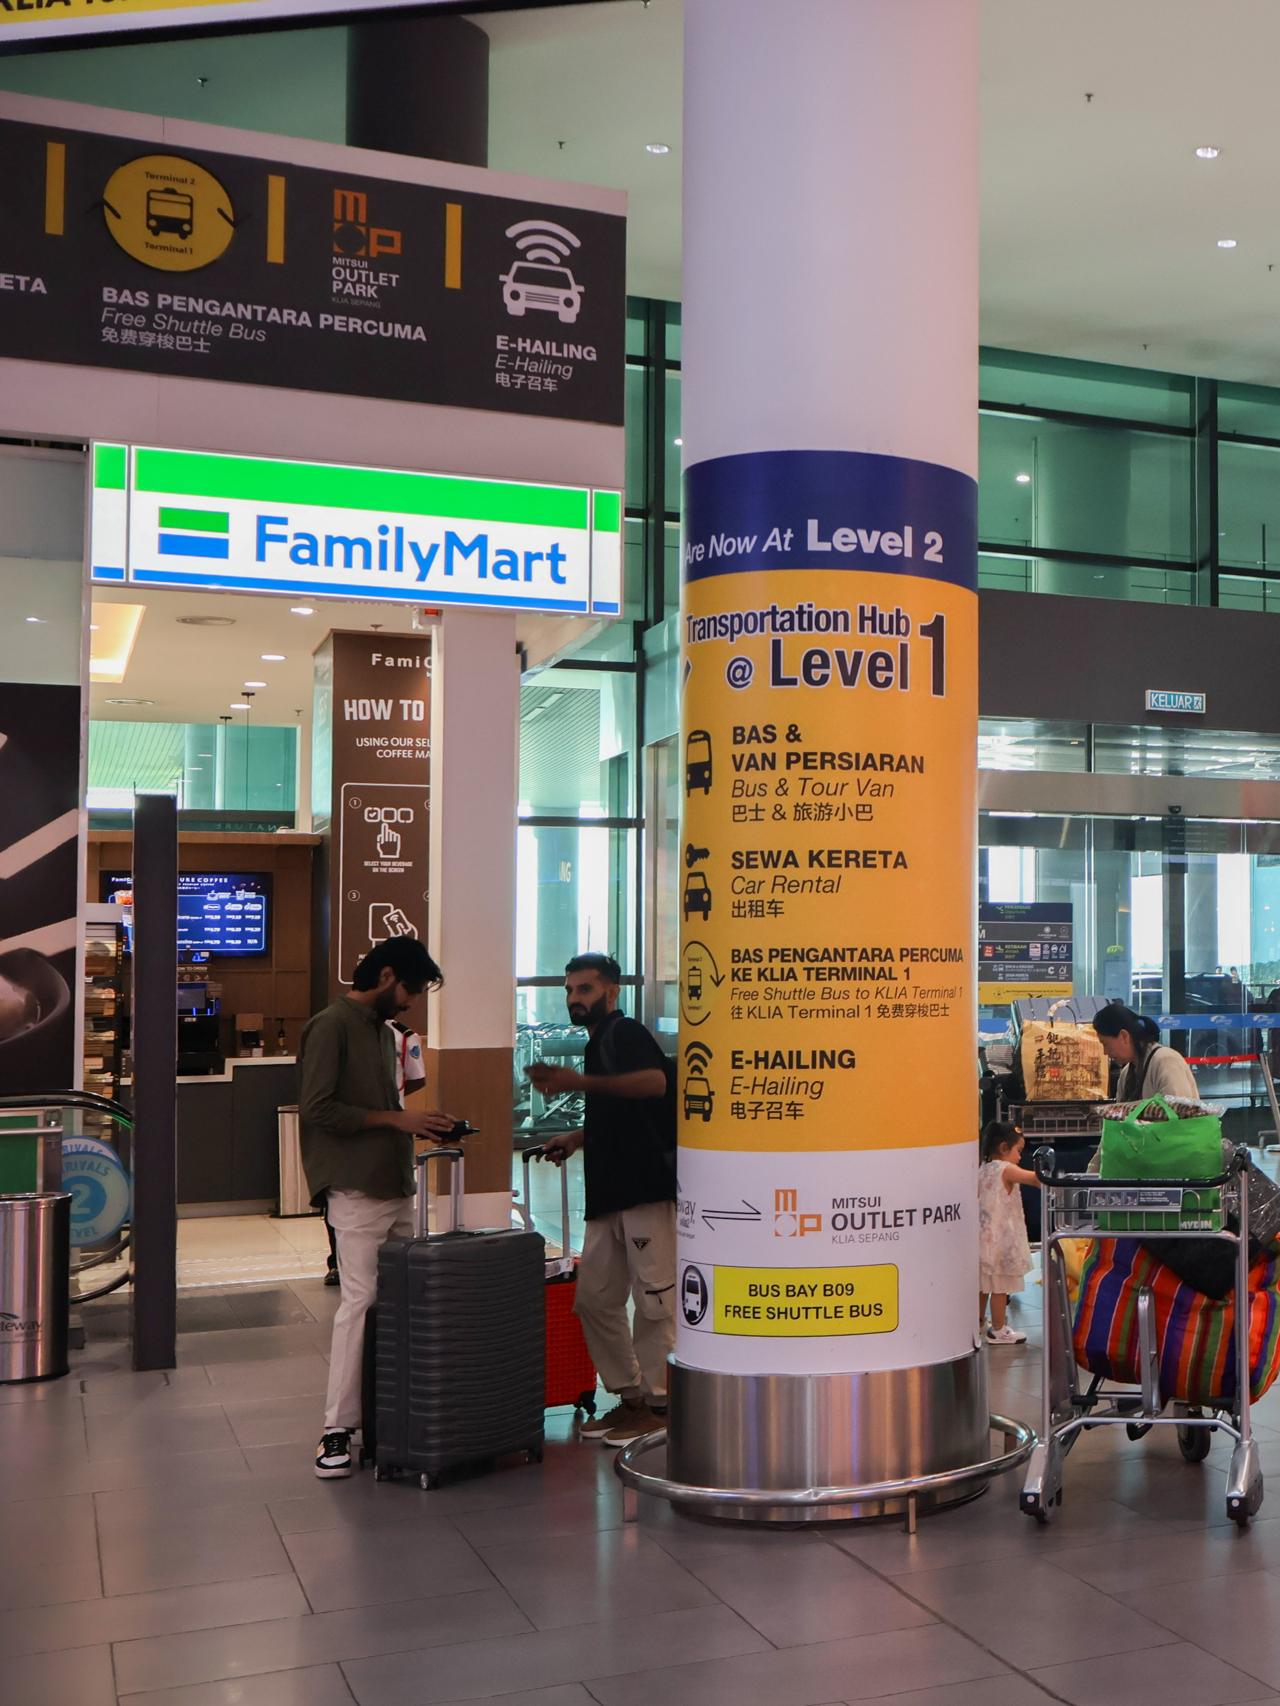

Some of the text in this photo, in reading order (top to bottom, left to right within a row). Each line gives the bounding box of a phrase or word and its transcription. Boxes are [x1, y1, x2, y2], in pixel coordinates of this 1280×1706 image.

[145, 171, 188, 184] Terminal
[145, 242, 187, 255] Terminal
[332, 256, 368, 269] MITSUI
[332, 267, 399, 287] OUTLET
[332, 281, 378, 299] PARK
[101, 307, 267, 342] Free Shuttle Bus
[102, 287, 427, 342] BAS PENGANTARA PERCUMA
[101, 327, 211, 354] 免费穿梭巴士
[496, 335, 597, 361] E-HAILING
[495, 354, 573, 380] E-Hailing
[495, 373, 558, 392] 电子召车
[255, 514, 567, 585] FamilyMart
[708, 533, 757, 558] Now
[762, 528, 794, 552] At
[807, 519, 913, 558] Level
[923, 531, 944, 564] 2
[685, 602, 911, 645] Transportation Hub
[726, 614, 946, 697] @ Level 1
[344, 699, 425, 721] HOW TO
[1151, 693, 1193, 709] KELUAR
[356, 737, 388, 747] USING
[390, 737, 413, 746] OUR
[733, 724, 802, 745] BAS &
[376, 749, 413, 758] COFFEE
[732, 752, 924, 774] VAN PERSIARAN
[731, 777, 894, 798] Bus & Tour Van
[732, 802, 873, 822] 巴士 & 旅游小巴
[731, 850, 908, 870] SEWA KERETA
[731, 875, 842, 895] Car Rental
[731, 899, 785, 919] 出租车
[731, 947, 963, 963] BAS PENGANTARA PERCUMA
[731, 966, 910, 982] KE KLIA TERMINAL 1
[730, 986, 963, 1000] Free Shuttle Bus to KLIA Terminal 1
[731, 1003, 950, 1019] 往 KLIA Terminal 1 免费穿梭巴士
[731, 1049, 856, 1070] E-HAILING
[730, 1076, 824, 1099] E-Hailing
[730, 1101, 804, 1120] 电子召车
[832, 1196, 881, 1210] MITSUI
[831, 1203, 961, 1232] OUTLET PARK
[831, 1232, 900, 1245] KLIA SEPANG
[748, 1283, 855, 1298] BUS BAY B09
[724, 1303, 883, 1320] FREE SHUTTLE BUS
